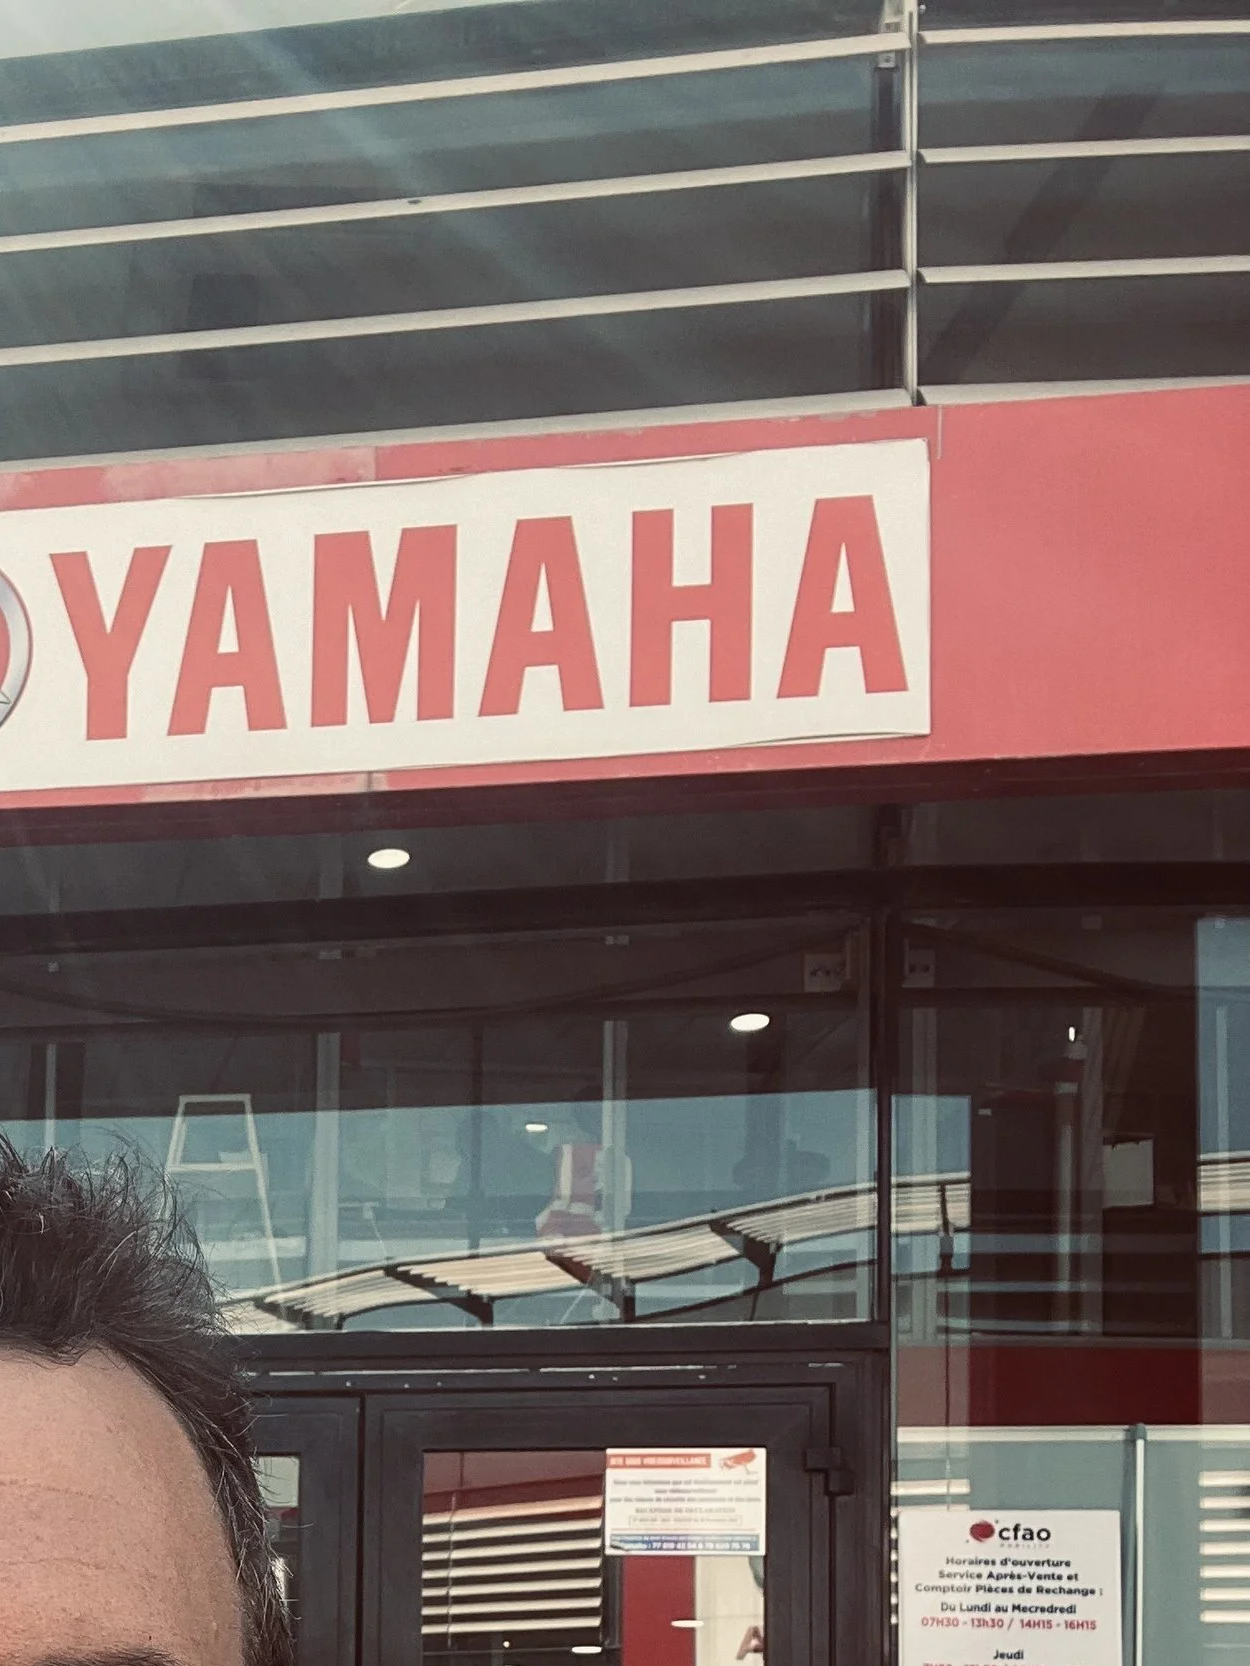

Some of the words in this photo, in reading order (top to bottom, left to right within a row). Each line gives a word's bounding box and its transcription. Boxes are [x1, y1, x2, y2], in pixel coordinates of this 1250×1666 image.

[48, 494, 908, 742] YAMAHA
[998, 1520, 1051, 1542] cfao
[945, 1556, 997, 1567] Horaires
[1000, 1556, 1071, 1568] d'ouverture
[938, 1570, 983, 1581] Service
[986, 1570, 1063, 1583] Après-Vente
[1067, 1572, 1079, 1582] et
[915, 1583, 972, 1596] Comptoir
[975, 1583, 1014, 1595] Pièces
[1018, 1584, 1033, 1595] de
[1036, 1585, 1096, 1597] Rechange
[940, 1602, 956, 1613] Du
[959, 1602, 992, 1614] Lundi
[995, 1605, 1008, 1614] au
[1011, 1603, 1077, 1615] Mecredredi
[921, 1617, 961, 1629] 07H30
[970, 1617, 1005, 1629] 13h30
[1019, 1619, 1053, 1630] 14H15
[1063, 1619, 1097, 1631] 16H15
[993, 1650, 1024, 1661] Jeudi
